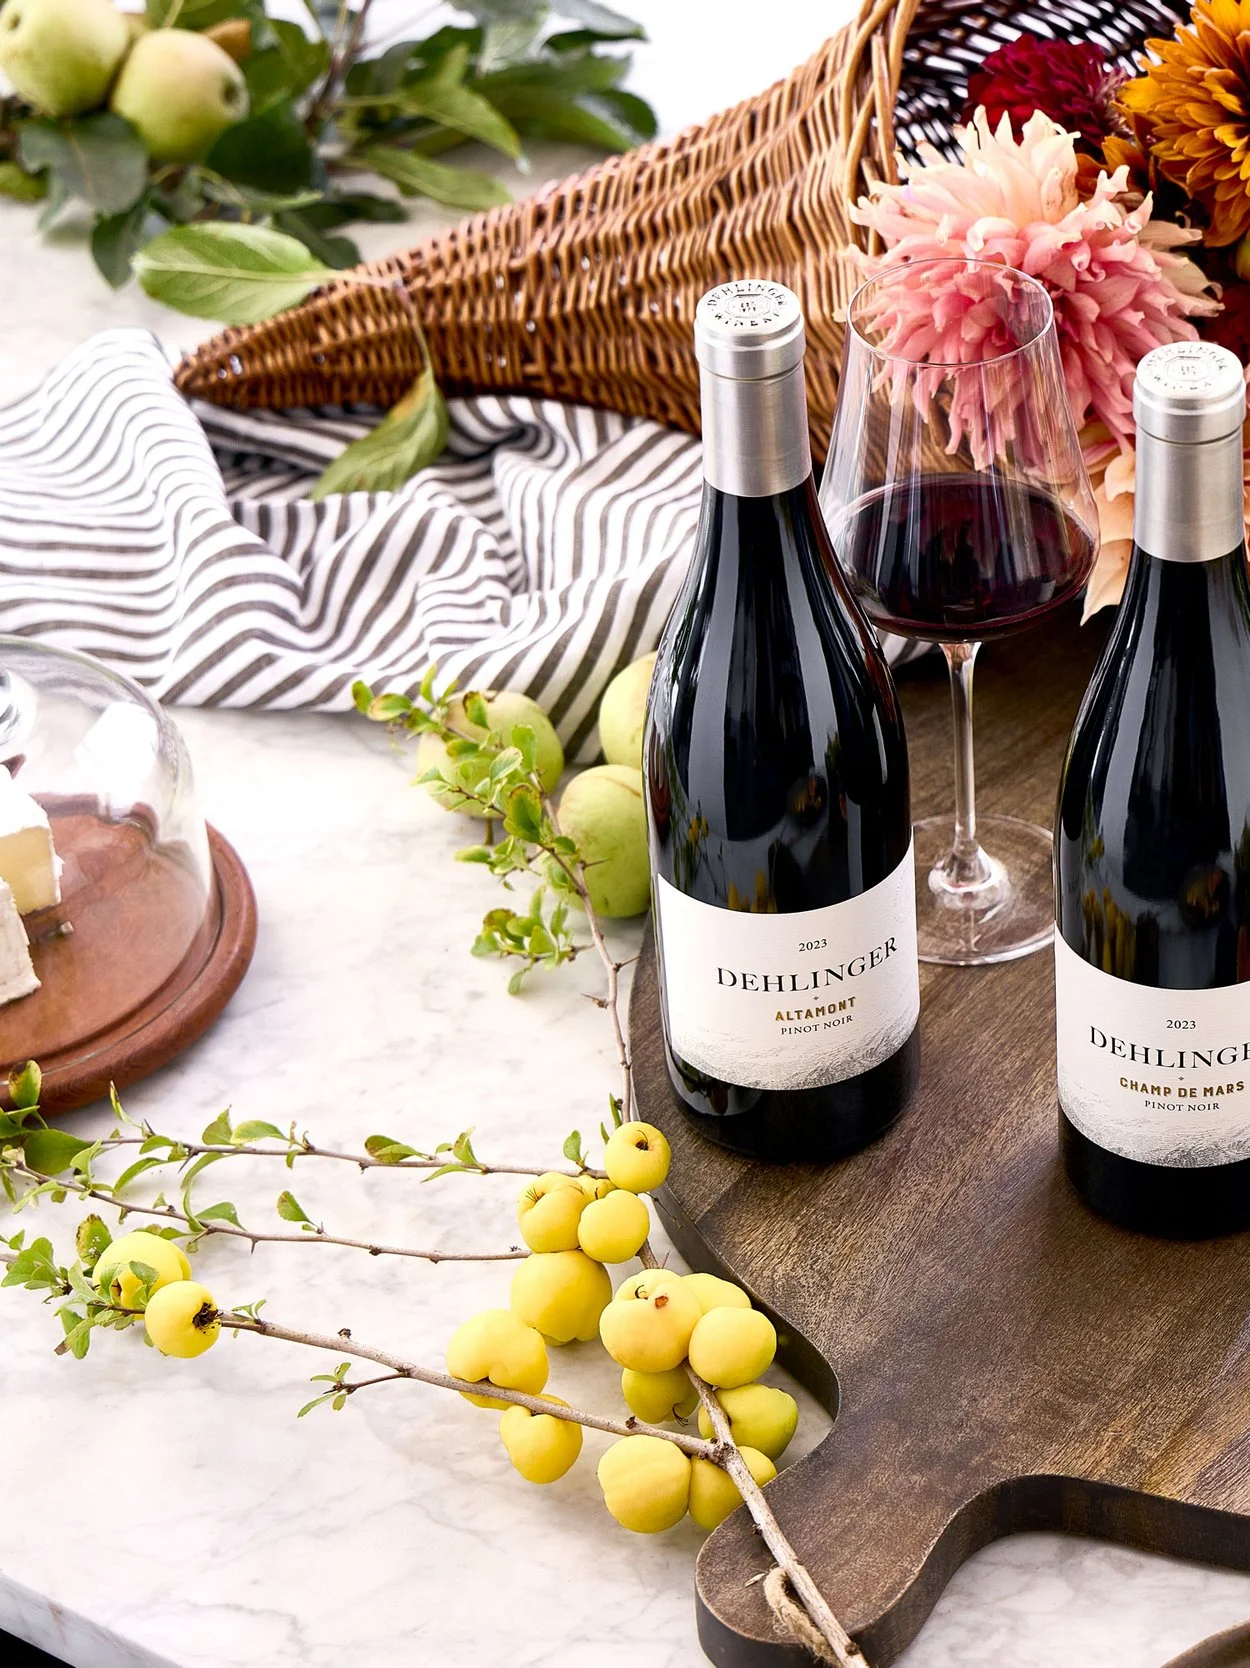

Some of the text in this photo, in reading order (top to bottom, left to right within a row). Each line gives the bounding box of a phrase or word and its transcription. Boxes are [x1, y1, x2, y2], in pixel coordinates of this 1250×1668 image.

[798, 938, 828, 952] 2023
[717, 936, 898, 993] DEHLINGER
[775, 996, 857, 1022] ALTAMONT
[781, 1014, 853, 1035] PINOT NOIR
[1166, 1019, 1197, 1030] 2023
[1119, 1076, 1246, 1098] CHAMP DE MARS
[1144, 1100, 1221, 1112] PINOT NOIR
